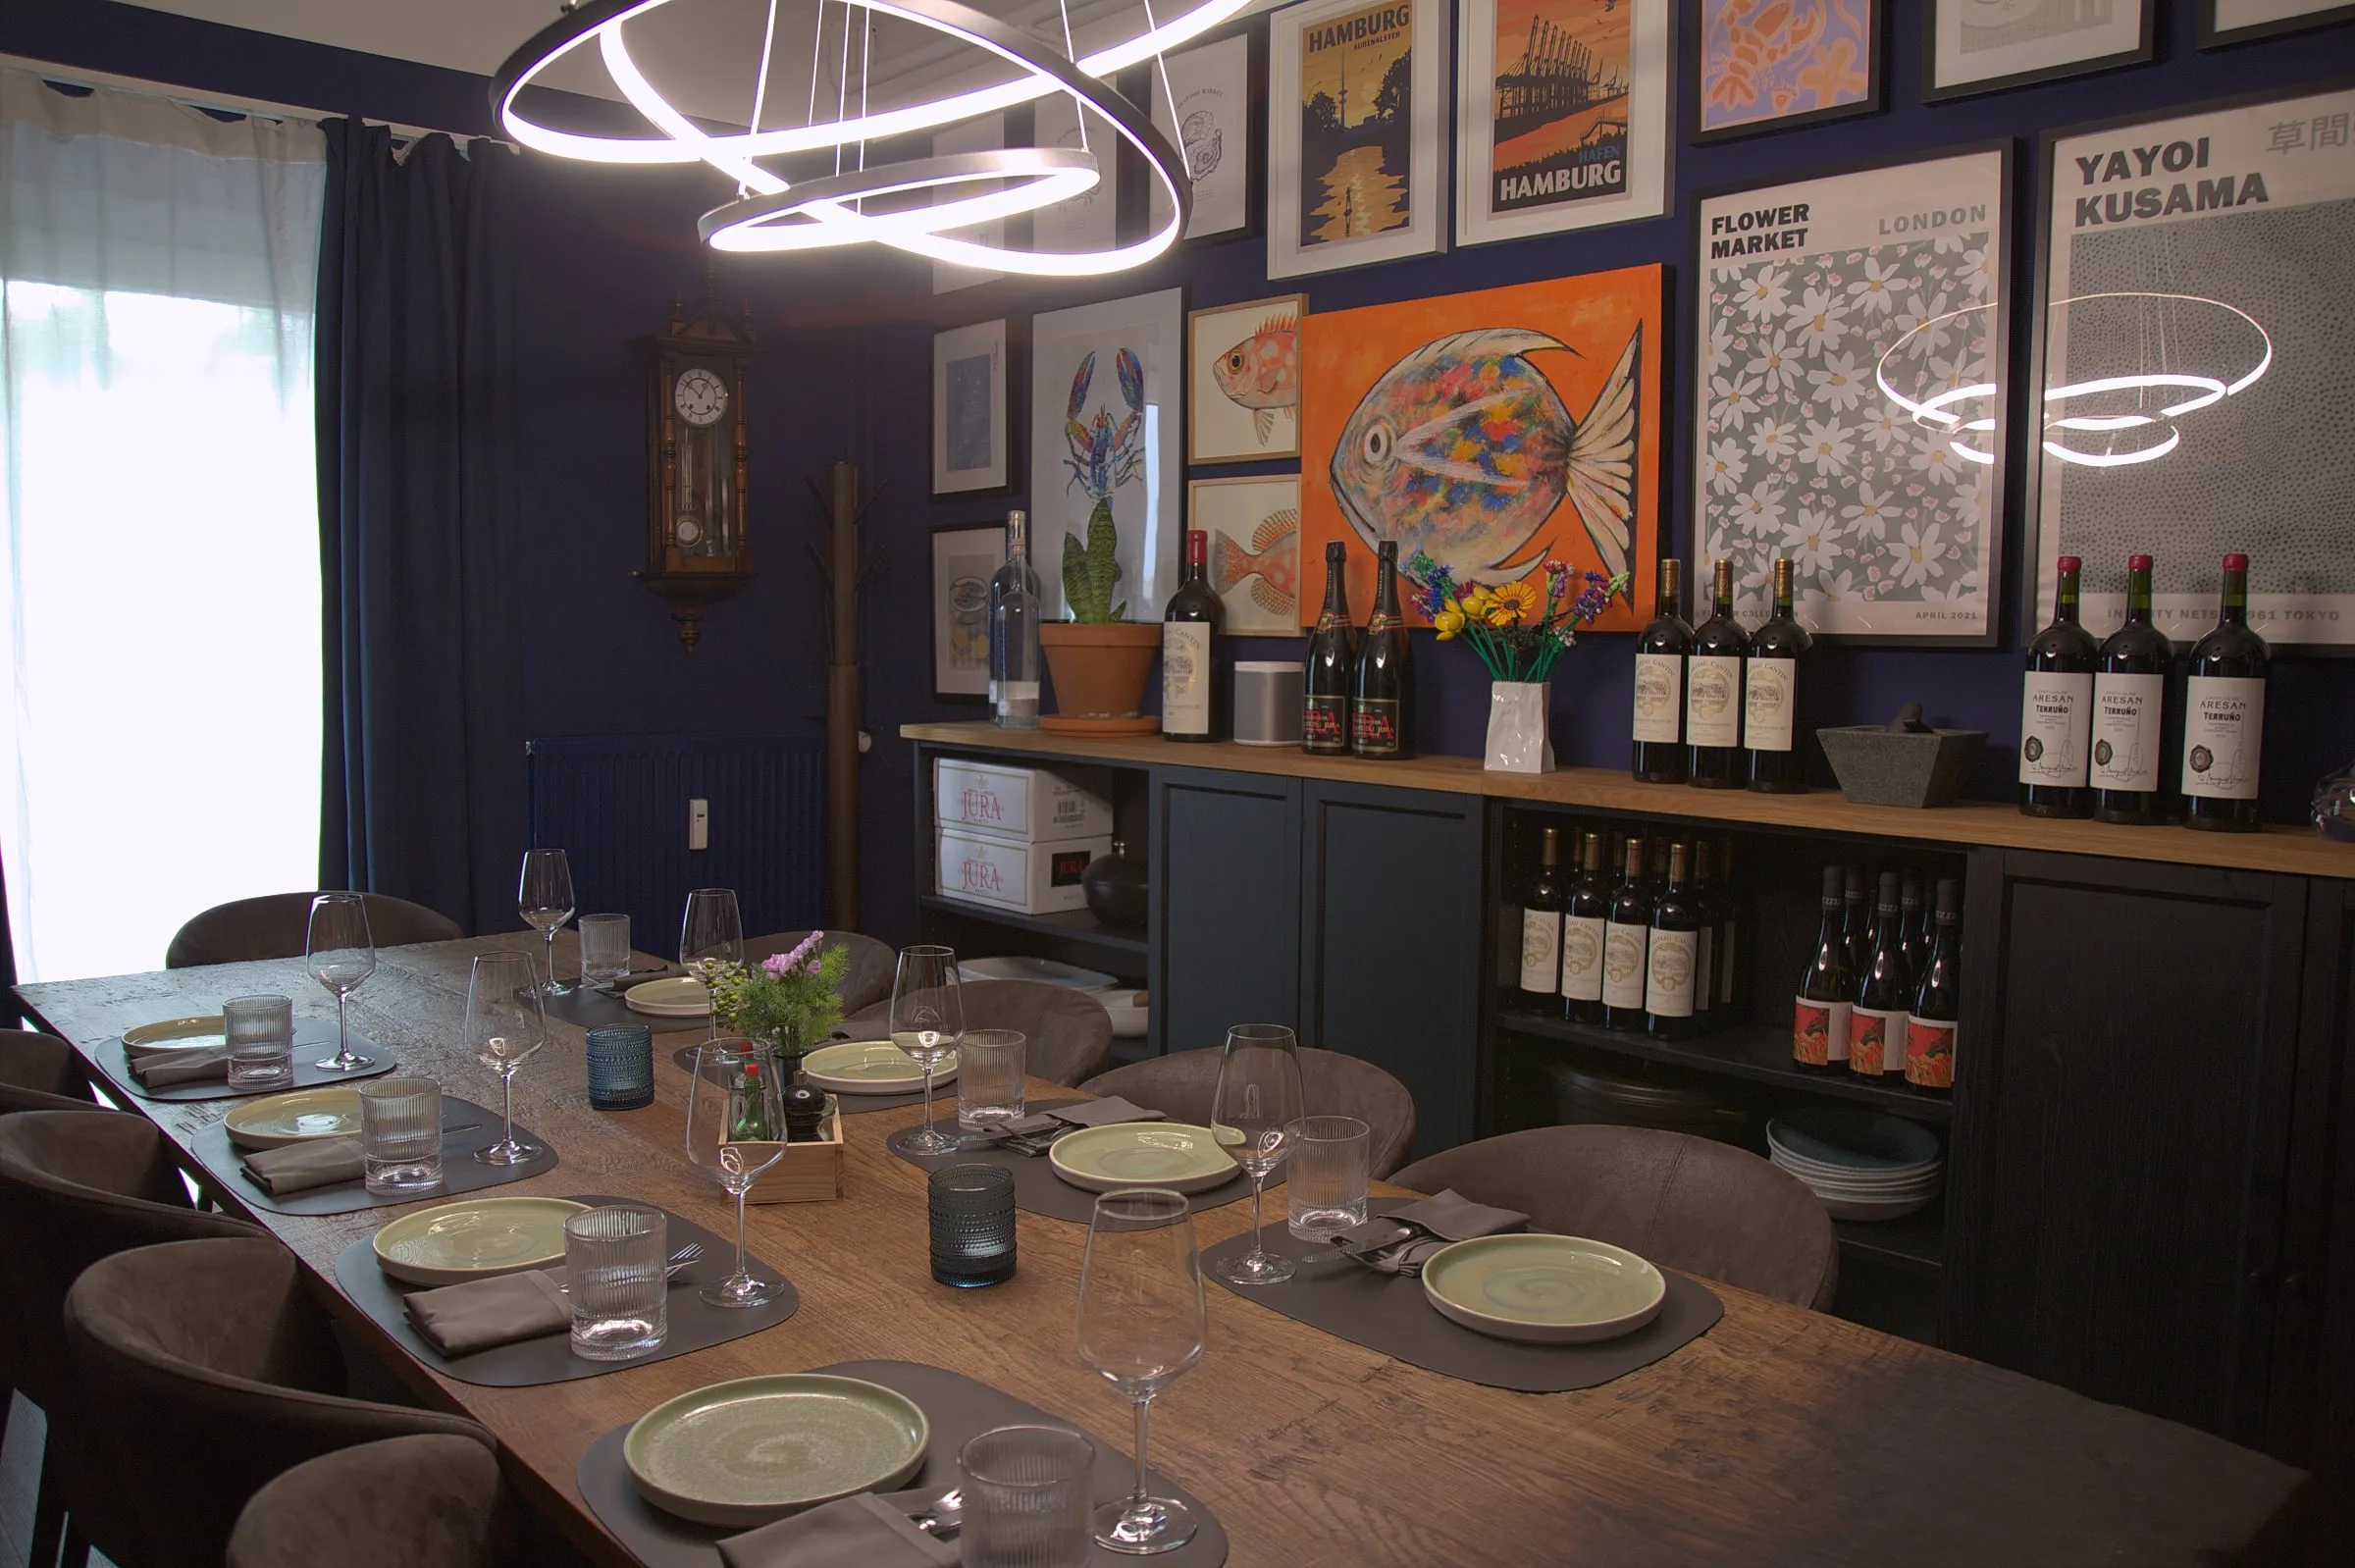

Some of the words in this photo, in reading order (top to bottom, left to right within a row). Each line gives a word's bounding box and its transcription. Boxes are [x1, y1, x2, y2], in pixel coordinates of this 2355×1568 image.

[1309, 5, 1409, 53] HAMBURG
[2266, 112, 2355, 156] 草間
[1578, 145, 1620, 164] HAFEN
[2075, 136, 2210, 185] YAYOI
[1500, 160, 1621, 201] HAMBURG
[2074, 172, 2269, 228] KUSAMA
[1711, 203, 1809, 235] FLOWER
[1878, 204, 1986, 235] LONDON
[1710, 228, 1808, 259] MARKET
[1915, 611, 1948, 620] APRIL
[1951, 611, 1978, 620] 2021
[2179, 609, 2218, 620] NETS
[2284, 609, 2340, 621] TOKYO
[2032, 694, 2074, 704] ARESAN
[2101, 696, 2143, 705] ARESAN
[2199, 701, 2246, 709] ARESAN
[962, 791, 1002, 820] JURA
[962, 862, 1000, 892] JURA
